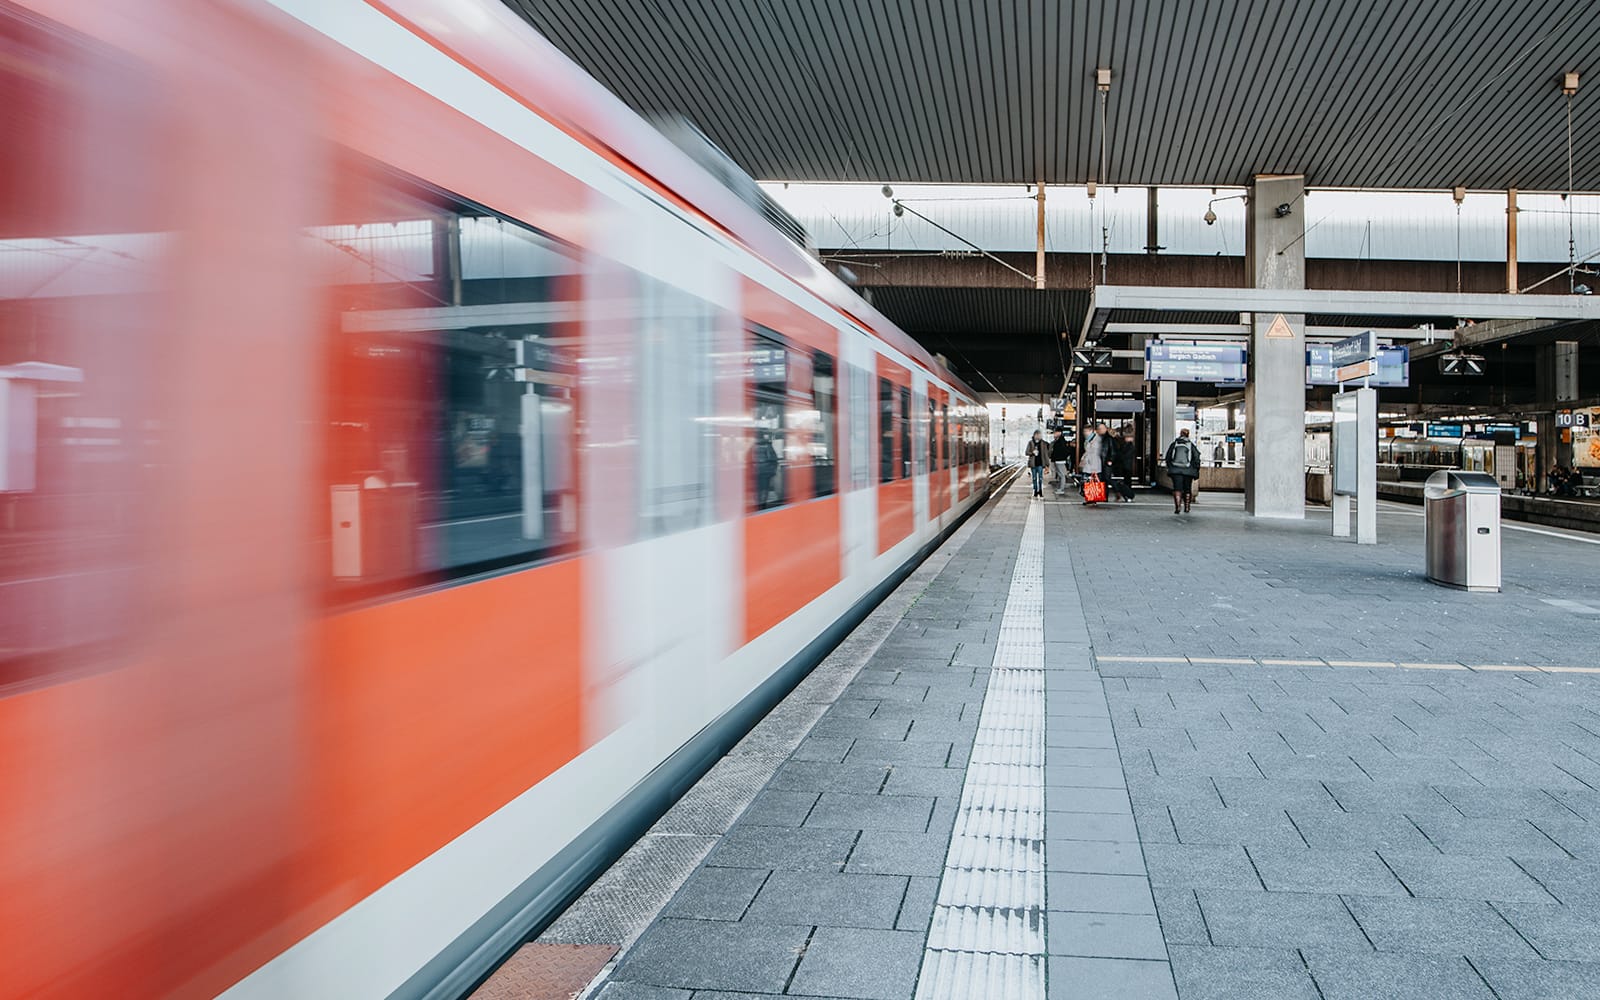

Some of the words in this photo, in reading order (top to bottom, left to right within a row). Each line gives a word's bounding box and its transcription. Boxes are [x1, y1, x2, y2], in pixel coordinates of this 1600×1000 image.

[1052, 398, 1064, 409] 12
[1558, 414, 1571, 425] 10
[1576, 414, 1584, 425] B
